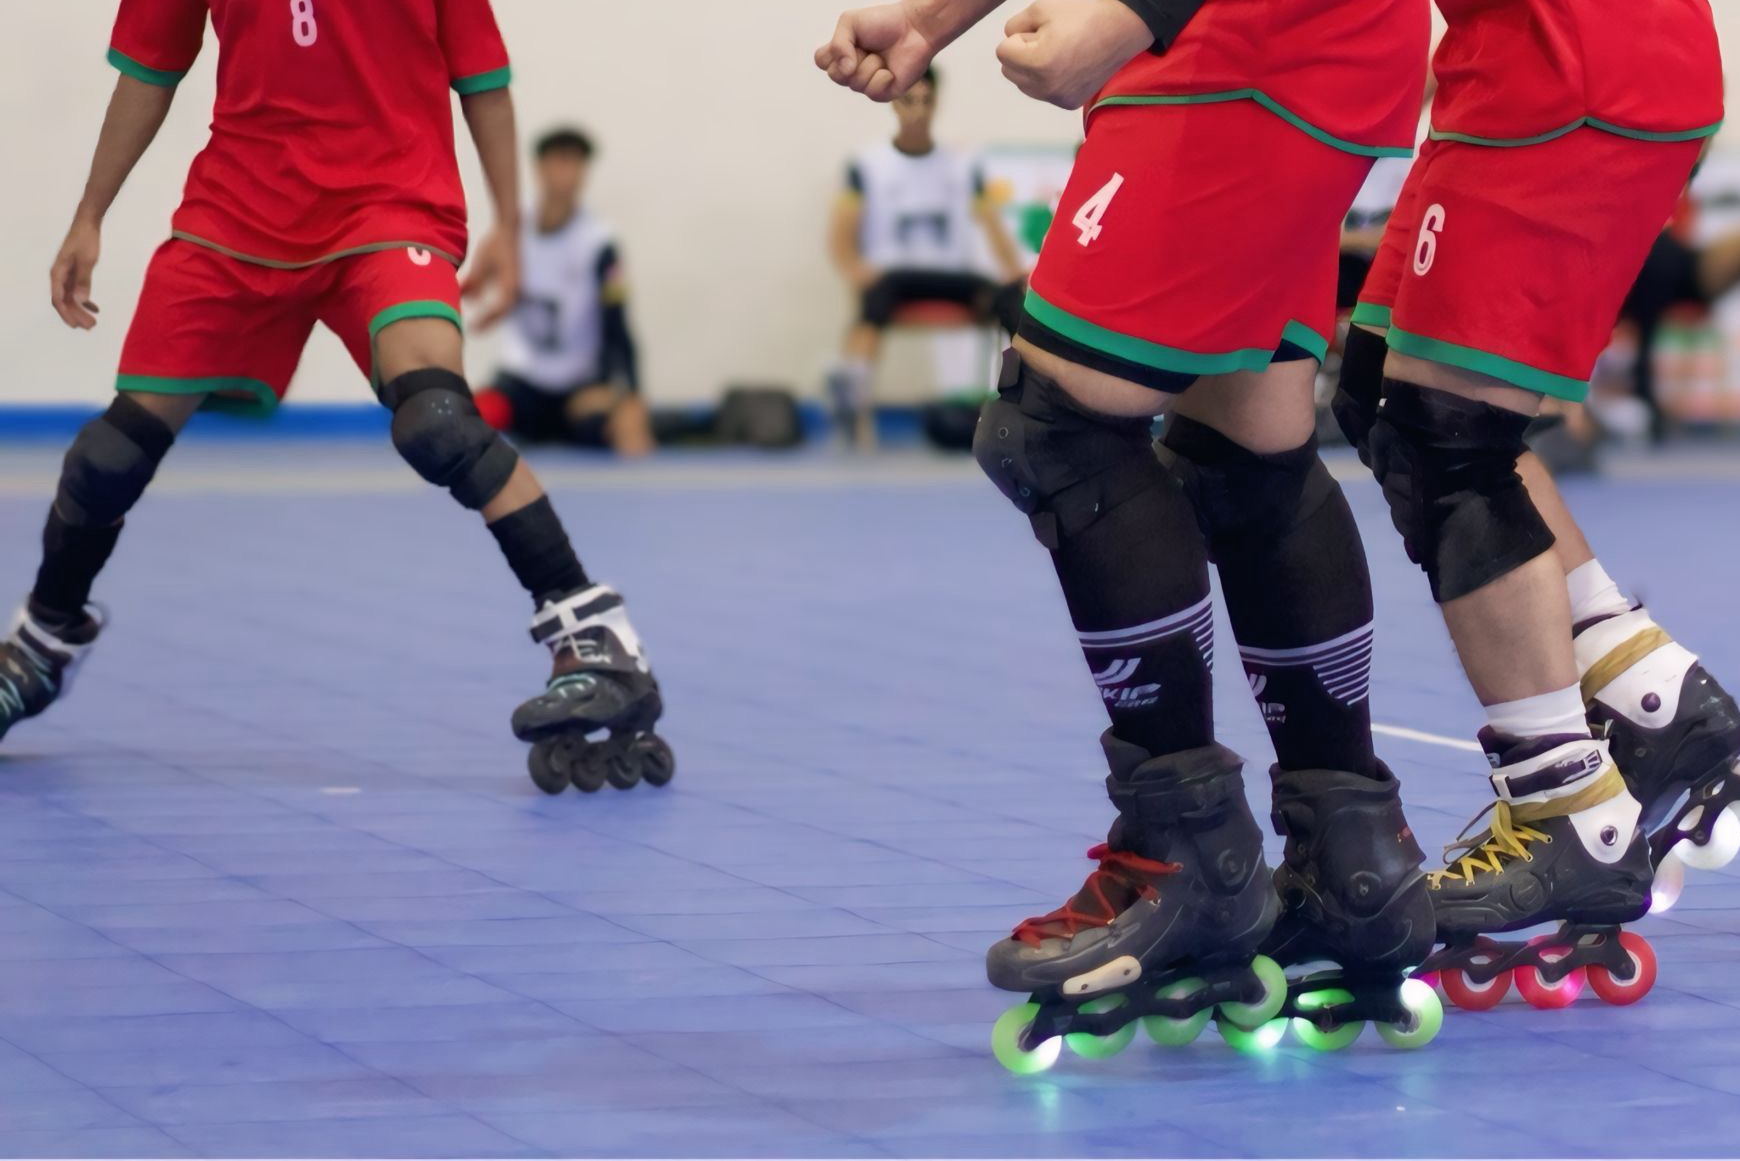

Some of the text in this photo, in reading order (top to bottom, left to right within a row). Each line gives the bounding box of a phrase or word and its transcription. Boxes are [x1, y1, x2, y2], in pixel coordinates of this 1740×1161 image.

[1072, 171, 1125, 248] 4
[1413, 203, 1446, 276] 6
[1100, 683, 1162, 700] KIP
